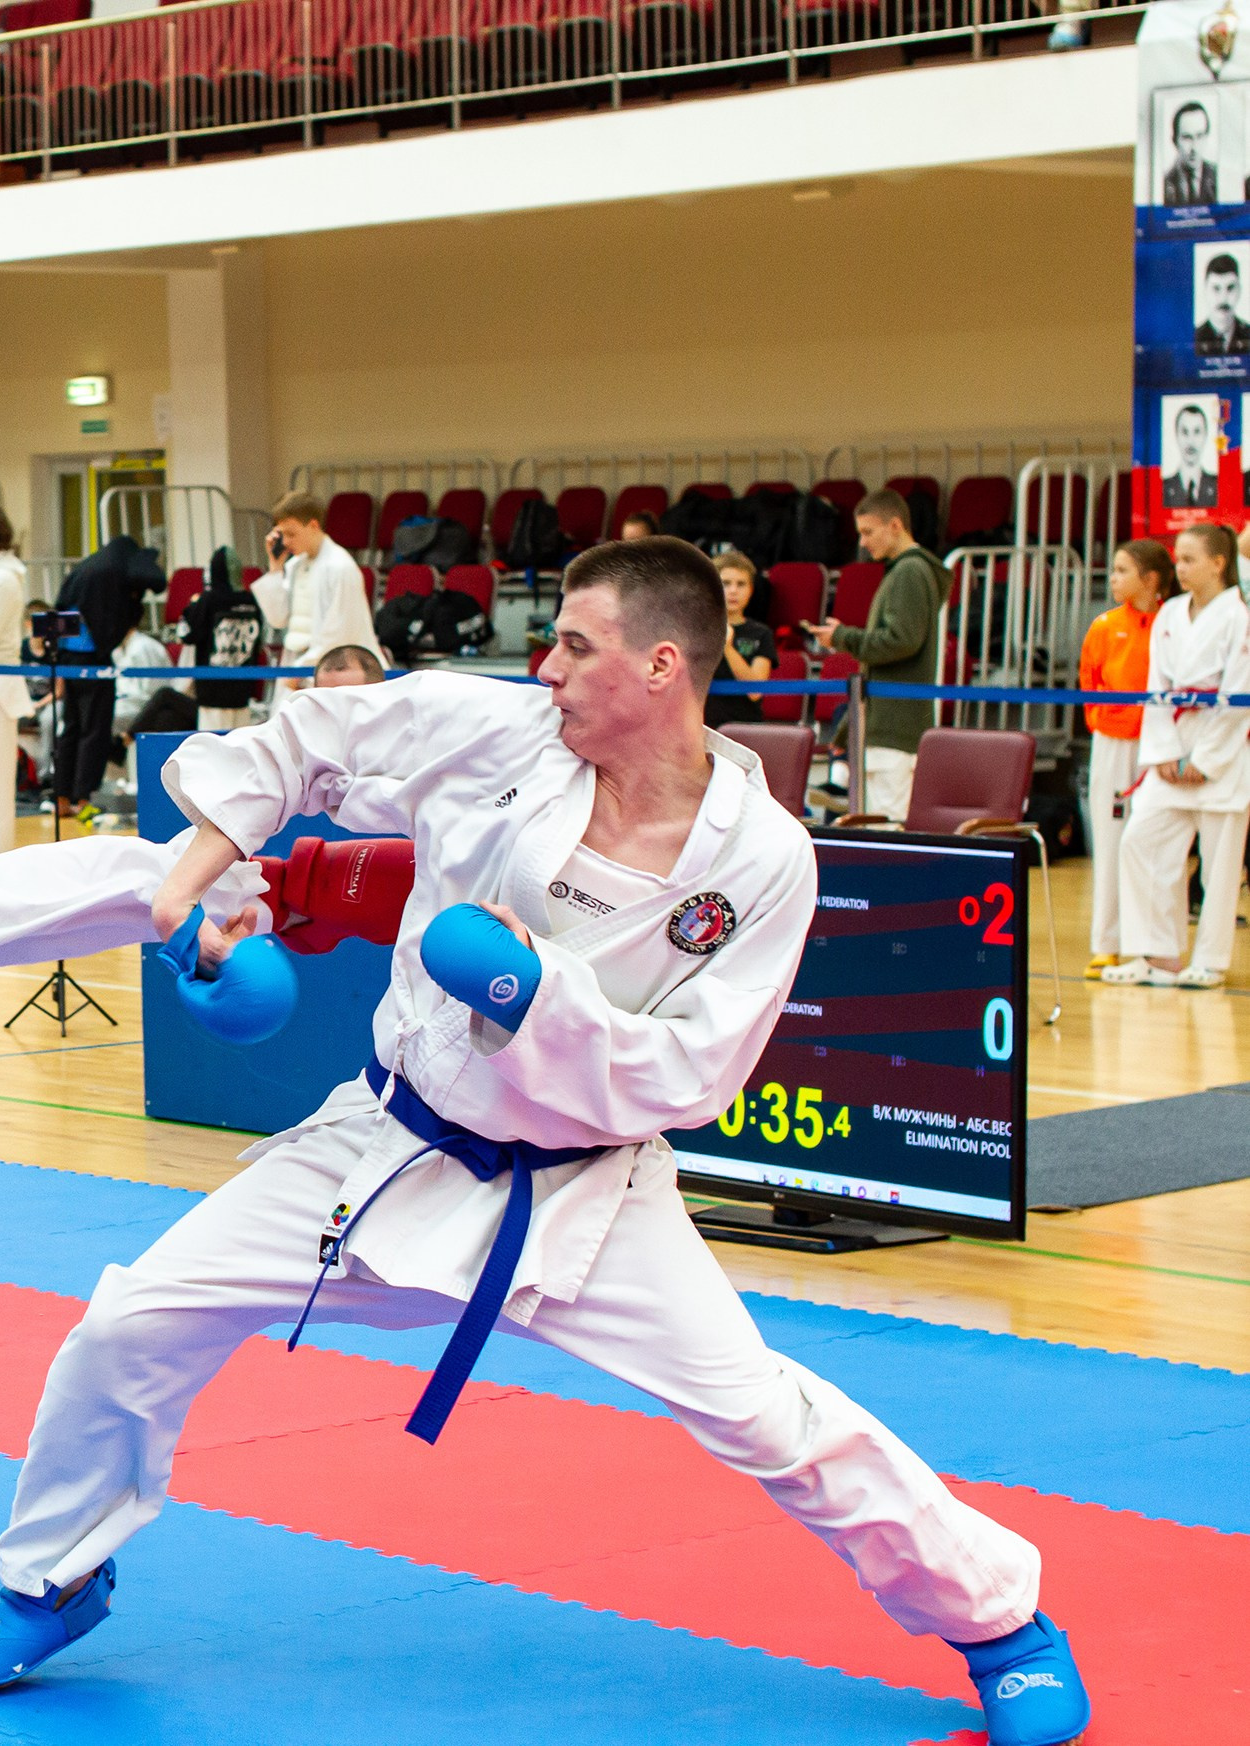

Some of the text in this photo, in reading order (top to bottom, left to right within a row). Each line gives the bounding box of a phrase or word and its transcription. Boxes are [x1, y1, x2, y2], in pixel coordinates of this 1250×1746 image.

[821, 895, 869, 910] FEDERATION
[781, 1001, 823, 1017] DERATION
[983, 997, 1014, 1061] 0
[873, 1104, 892, 1120] В/К
[894, 1107, 956, 1129] МУЖЧИНЫ
[966, 1117, 1012, 1137] АБС.ВЕС
[906, 1130, 1012, 1159] ELIMINATION POOL
